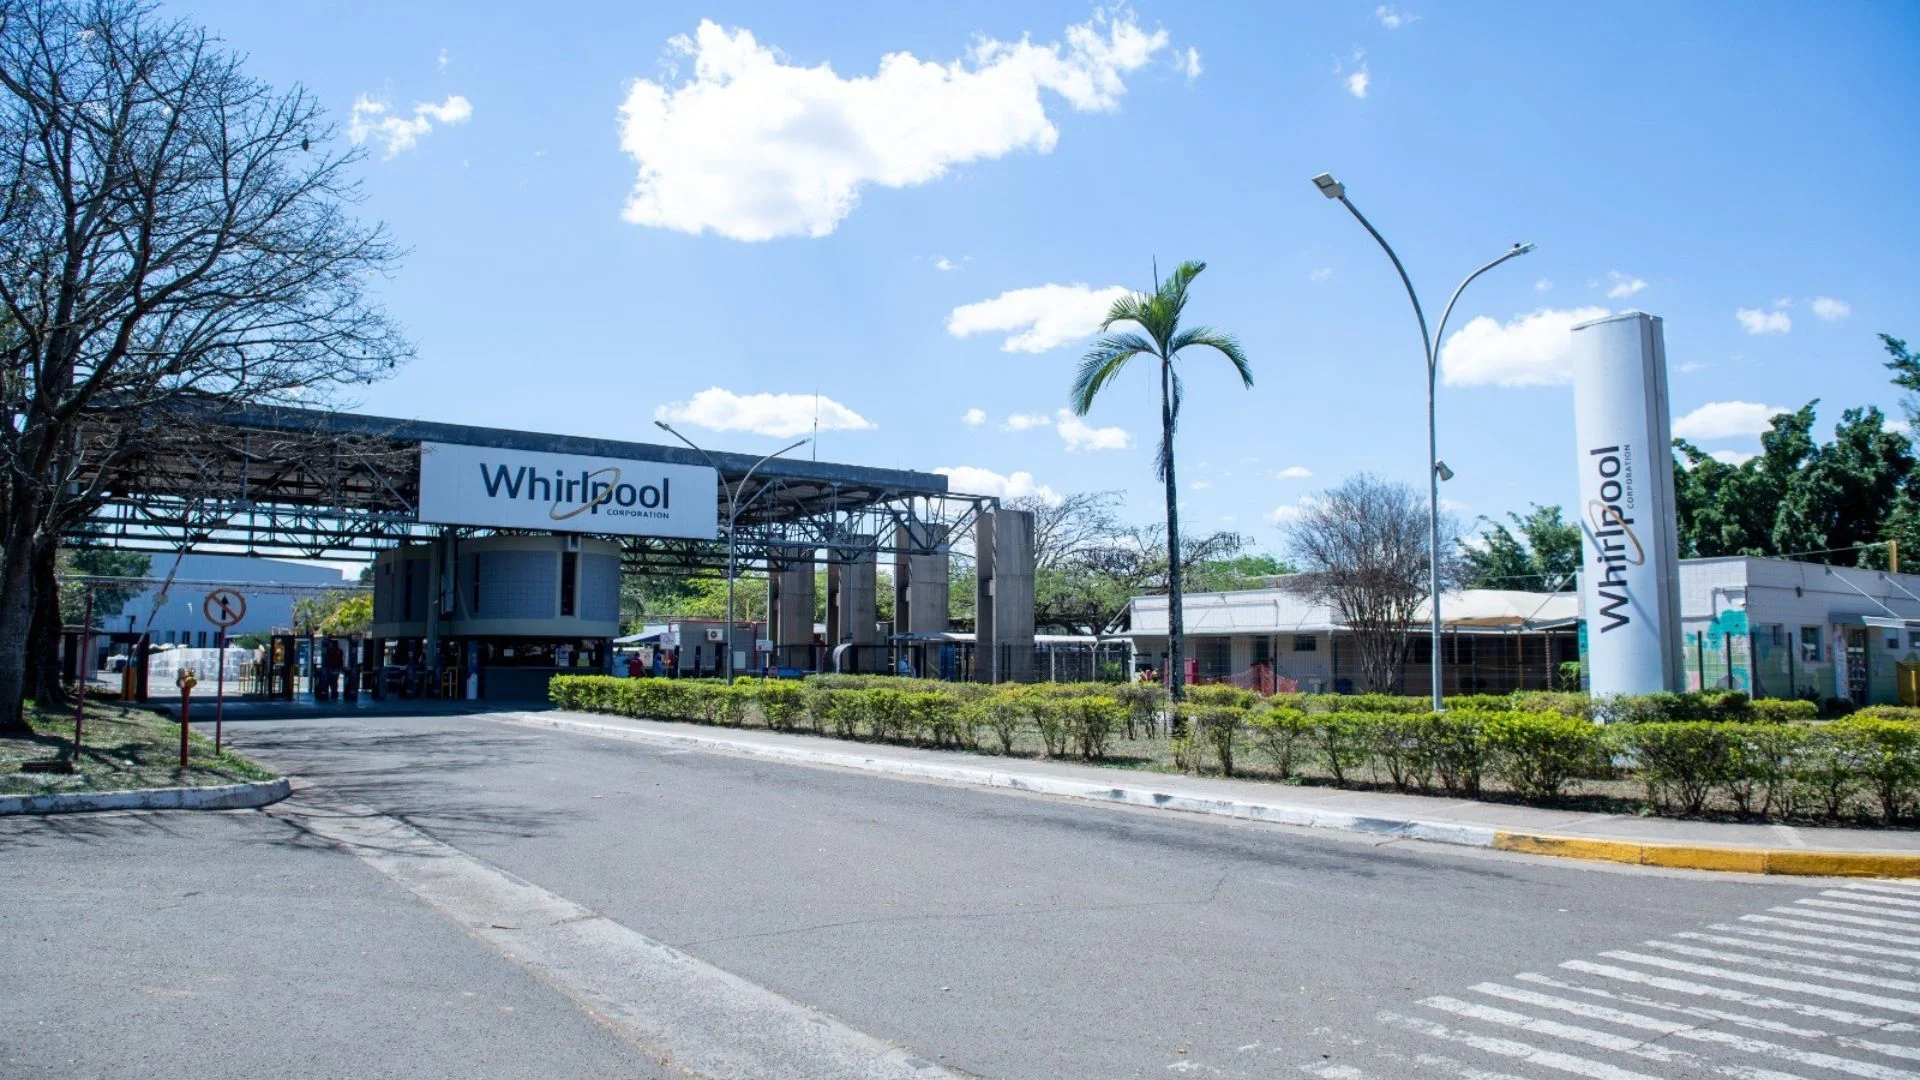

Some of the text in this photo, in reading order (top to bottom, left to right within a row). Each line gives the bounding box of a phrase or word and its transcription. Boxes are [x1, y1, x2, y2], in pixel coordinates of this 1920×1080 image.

[480, 462, 670, 515] Whirlpool
[1624, 444, 1634, 510] CORPORATION
[606, 508, 670, 519] CORPORATION
[1590, 445, 1634, 634] Whirlpool
